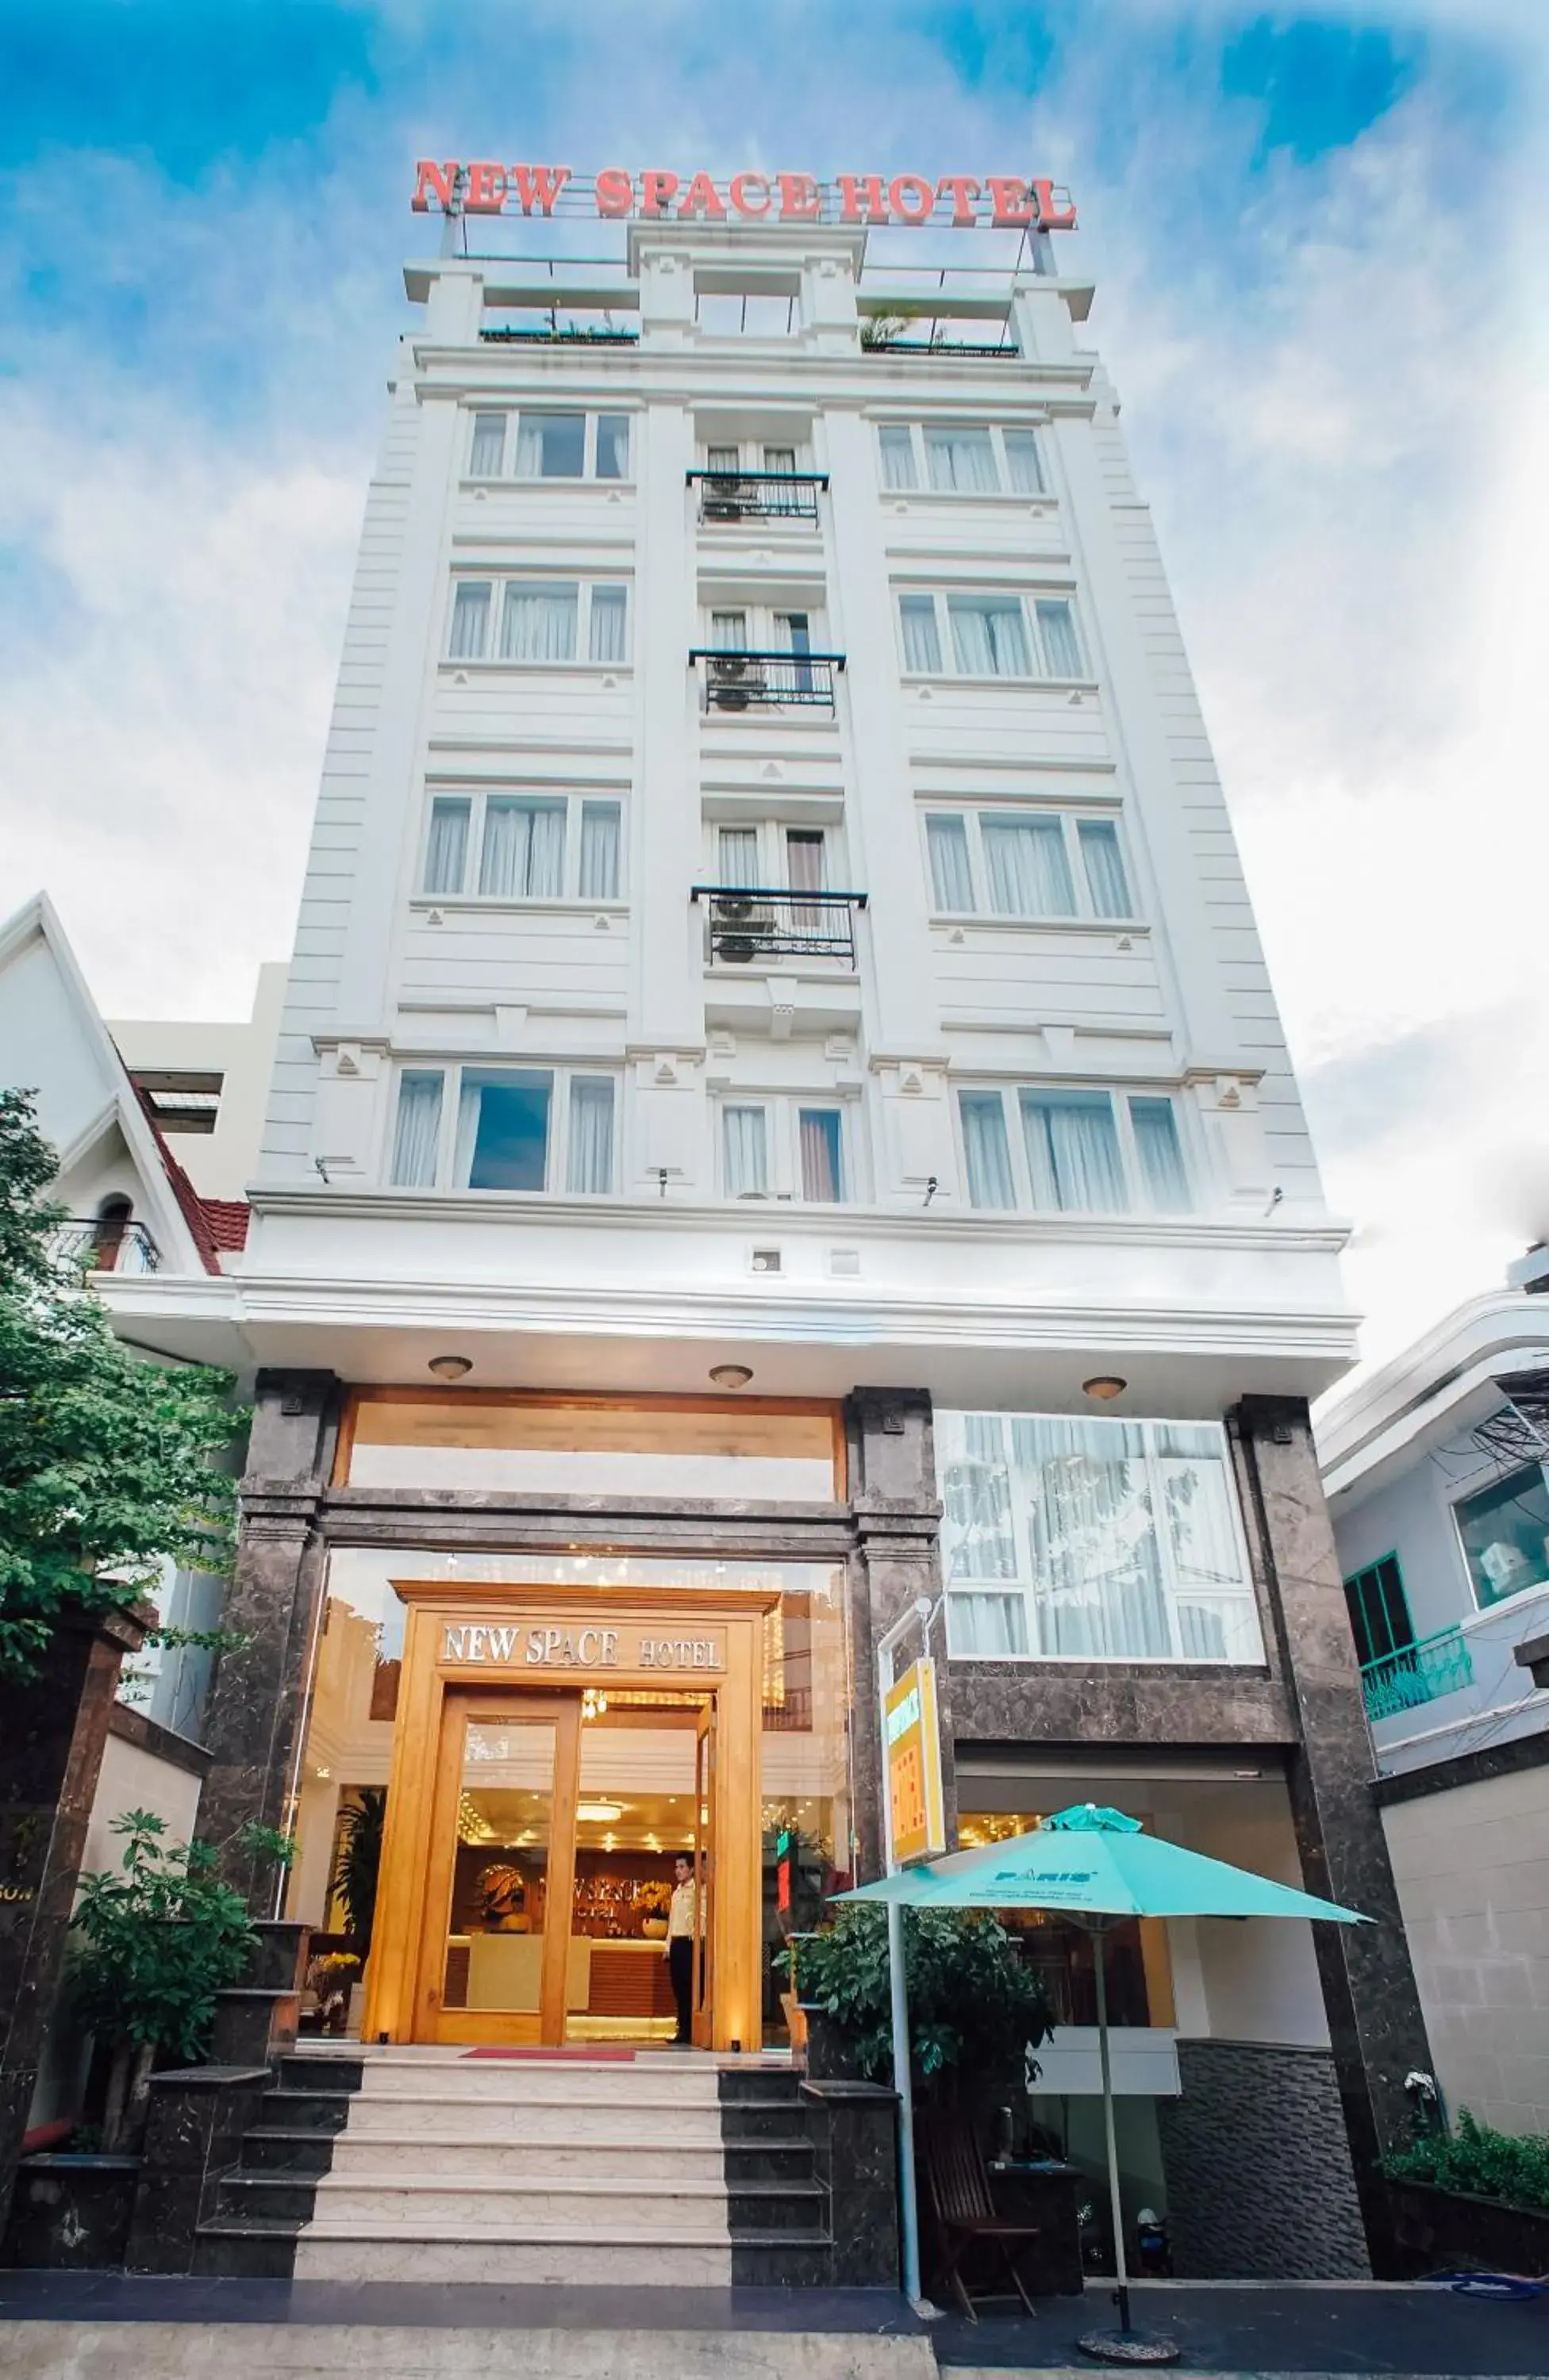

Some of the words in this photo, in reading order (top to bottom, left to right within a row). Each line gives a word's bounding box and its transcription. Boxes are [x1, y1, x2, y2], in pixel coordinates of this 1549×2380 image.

[412, 161, 572, 217] NEW
[594, 168, 821, 224] SPACE
[836, 173, 1078, 230] HOTEL
[442, 1625, 521, 1663] NEW
[525, 1629, 620, 1667] SPACE
[638, 1639, 722, 1670] HOTEL
